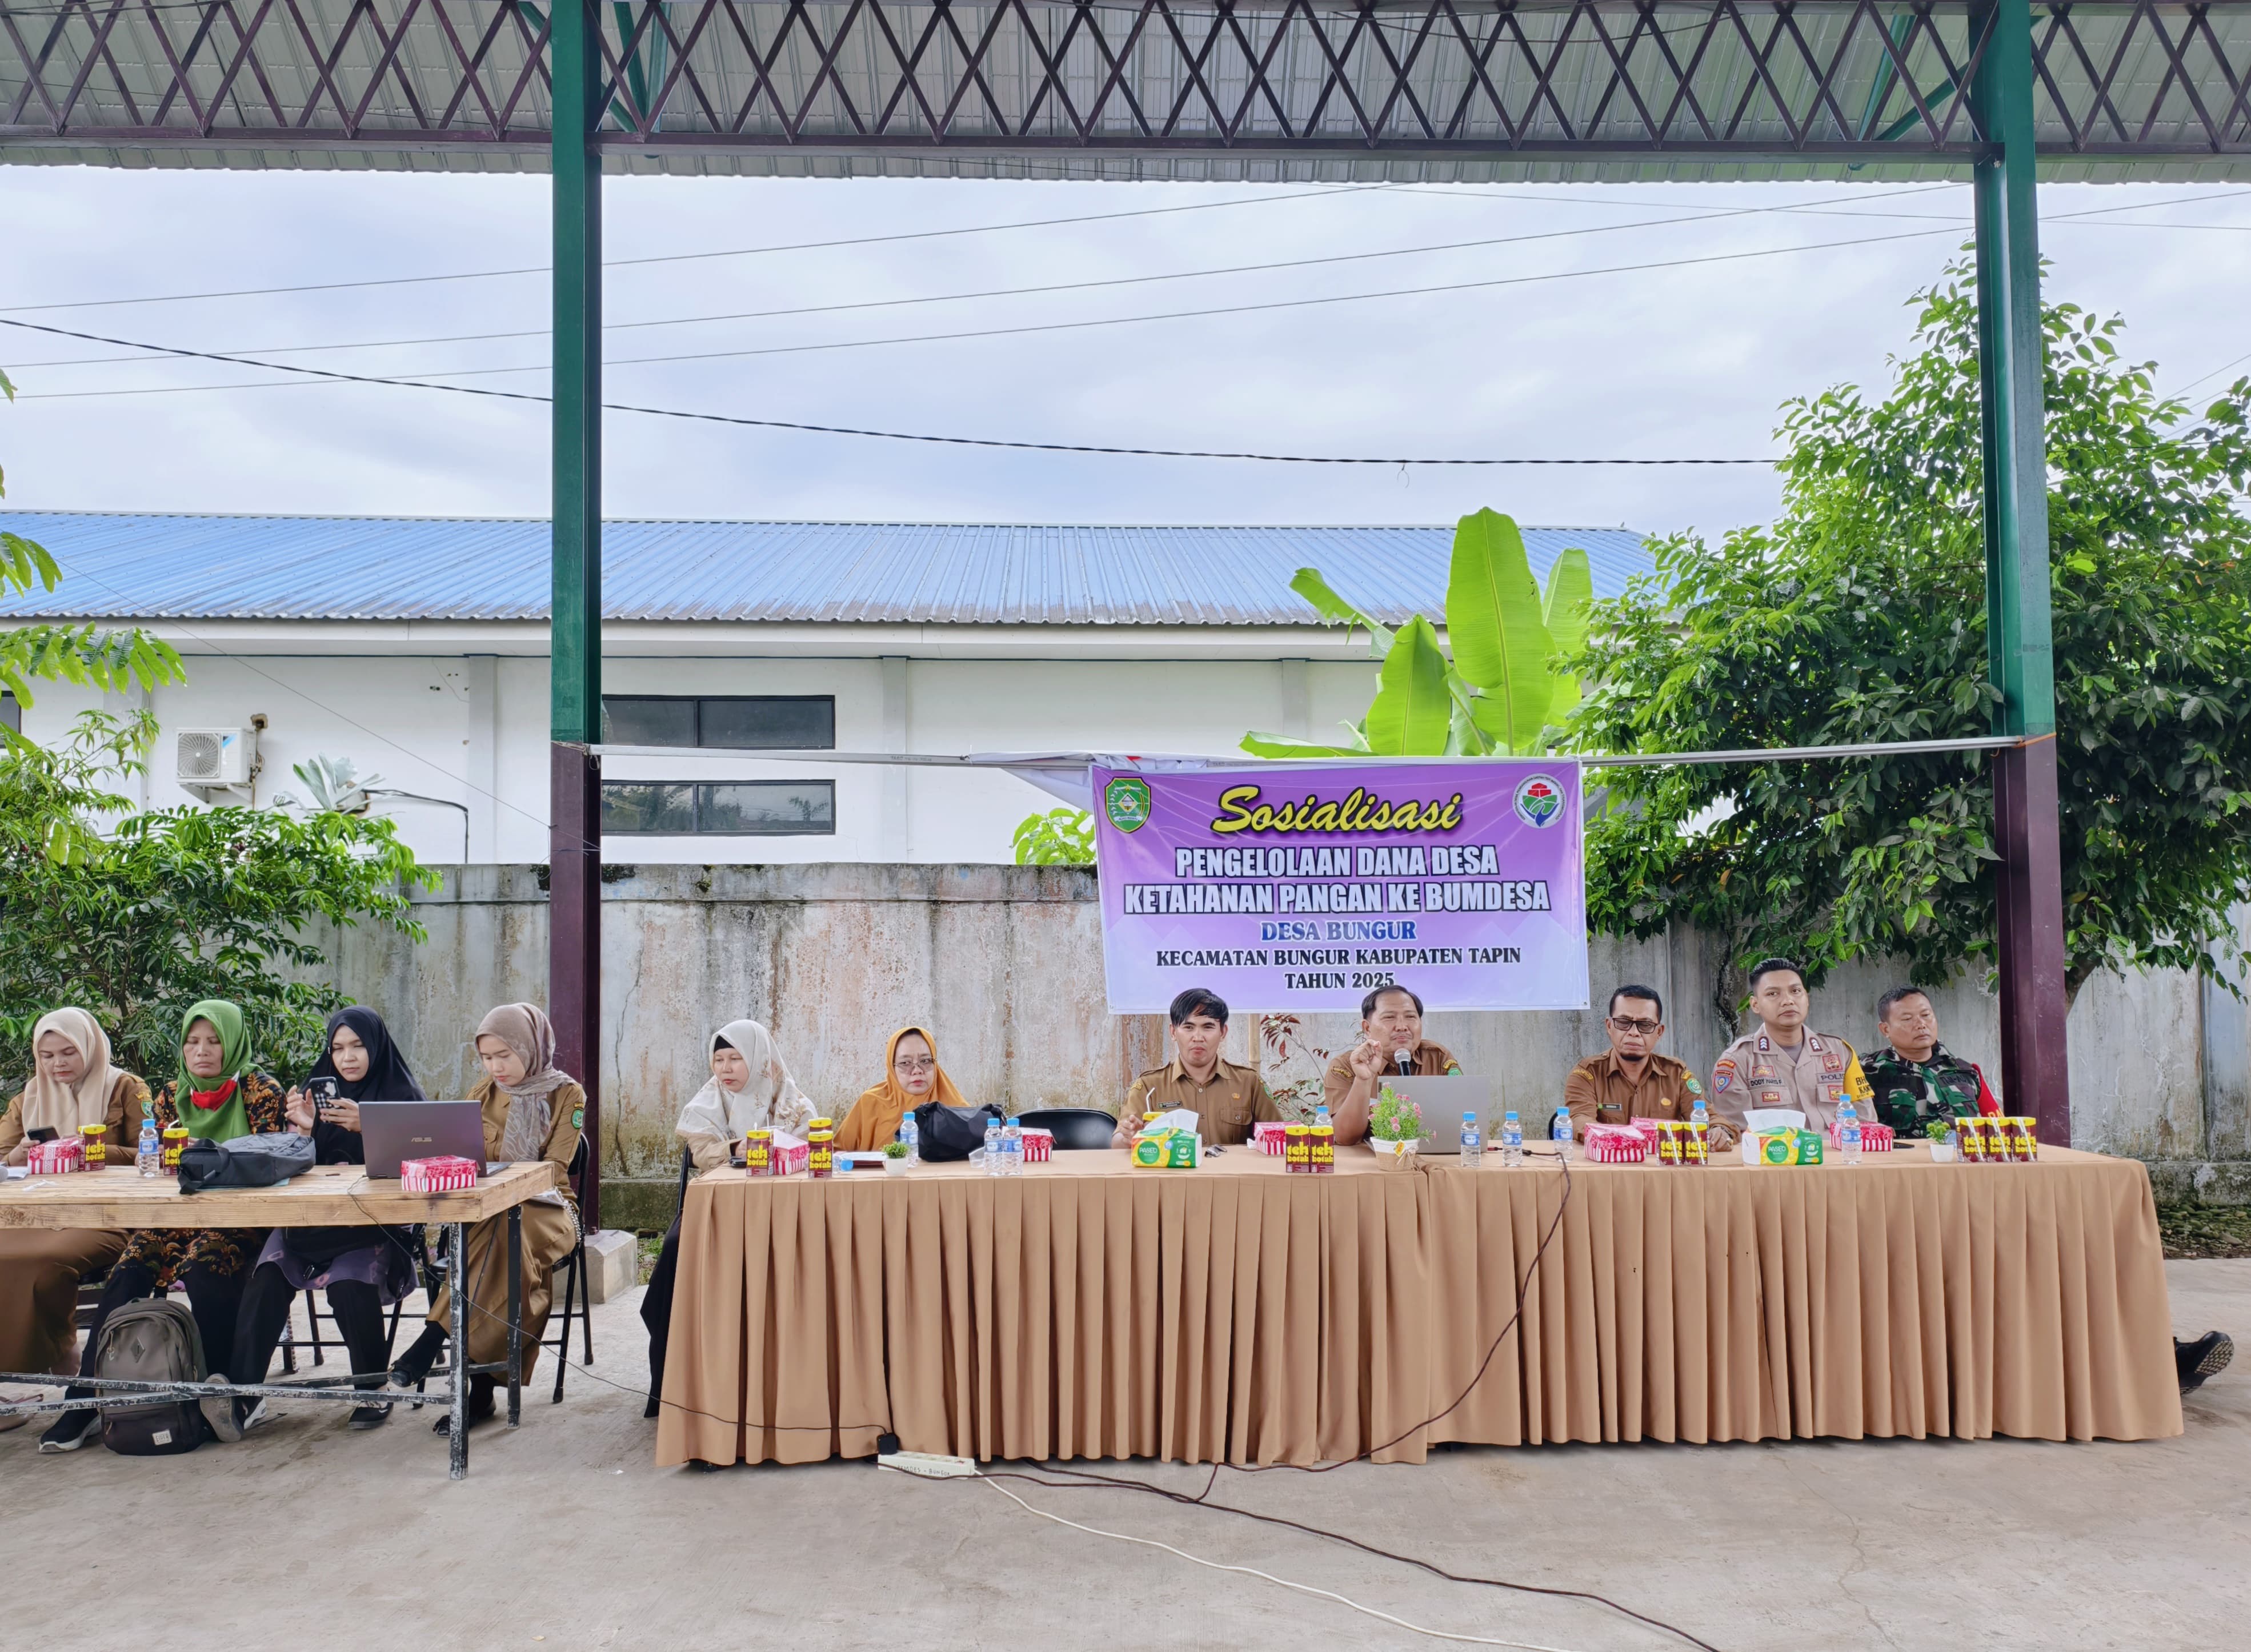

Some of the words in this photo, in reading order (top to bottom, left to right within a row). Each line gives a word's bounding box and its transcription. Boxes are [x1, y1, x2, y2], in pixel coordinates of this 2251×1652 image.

[1212, 785, 1461, 832] Sosialisasi
[1176, 847, 1352, 877] PENGELOLAAN
[1356, 846, 1428, 876] DANA
[1431, 845, 1500, 876] DESA
[1124, 884, 1274, 914] KETAHANAN
[1277, 883, 1383, 913] PANGAN
[1387, 882, 1421, 912] KE
[1423, 880, 1551, 912] BUMDESA
[1261, 922, 1320, 941] DESA
[1327, 921, 1416, 940] BUNGUR
[1156, 951, 1268, 966] KECAMATAN
[1274, 949, 1350, 965] BUNGUR
[1356, 948, 1463, 964] KABUPATEN
[1469, 948, 1520, 963] TAPIN
[1285, 973, 1345, 989] TAHUN
[1352, 972, 1394, 988] 2025
[86, 1140, 105, 1154] teh
[747, 1145, 768, 1158] teh
[810, 1147, 831, 1161] teh
[1287, 1142, 1309, 1155] teh
[1311, 1142, 1333, 1156] teh
